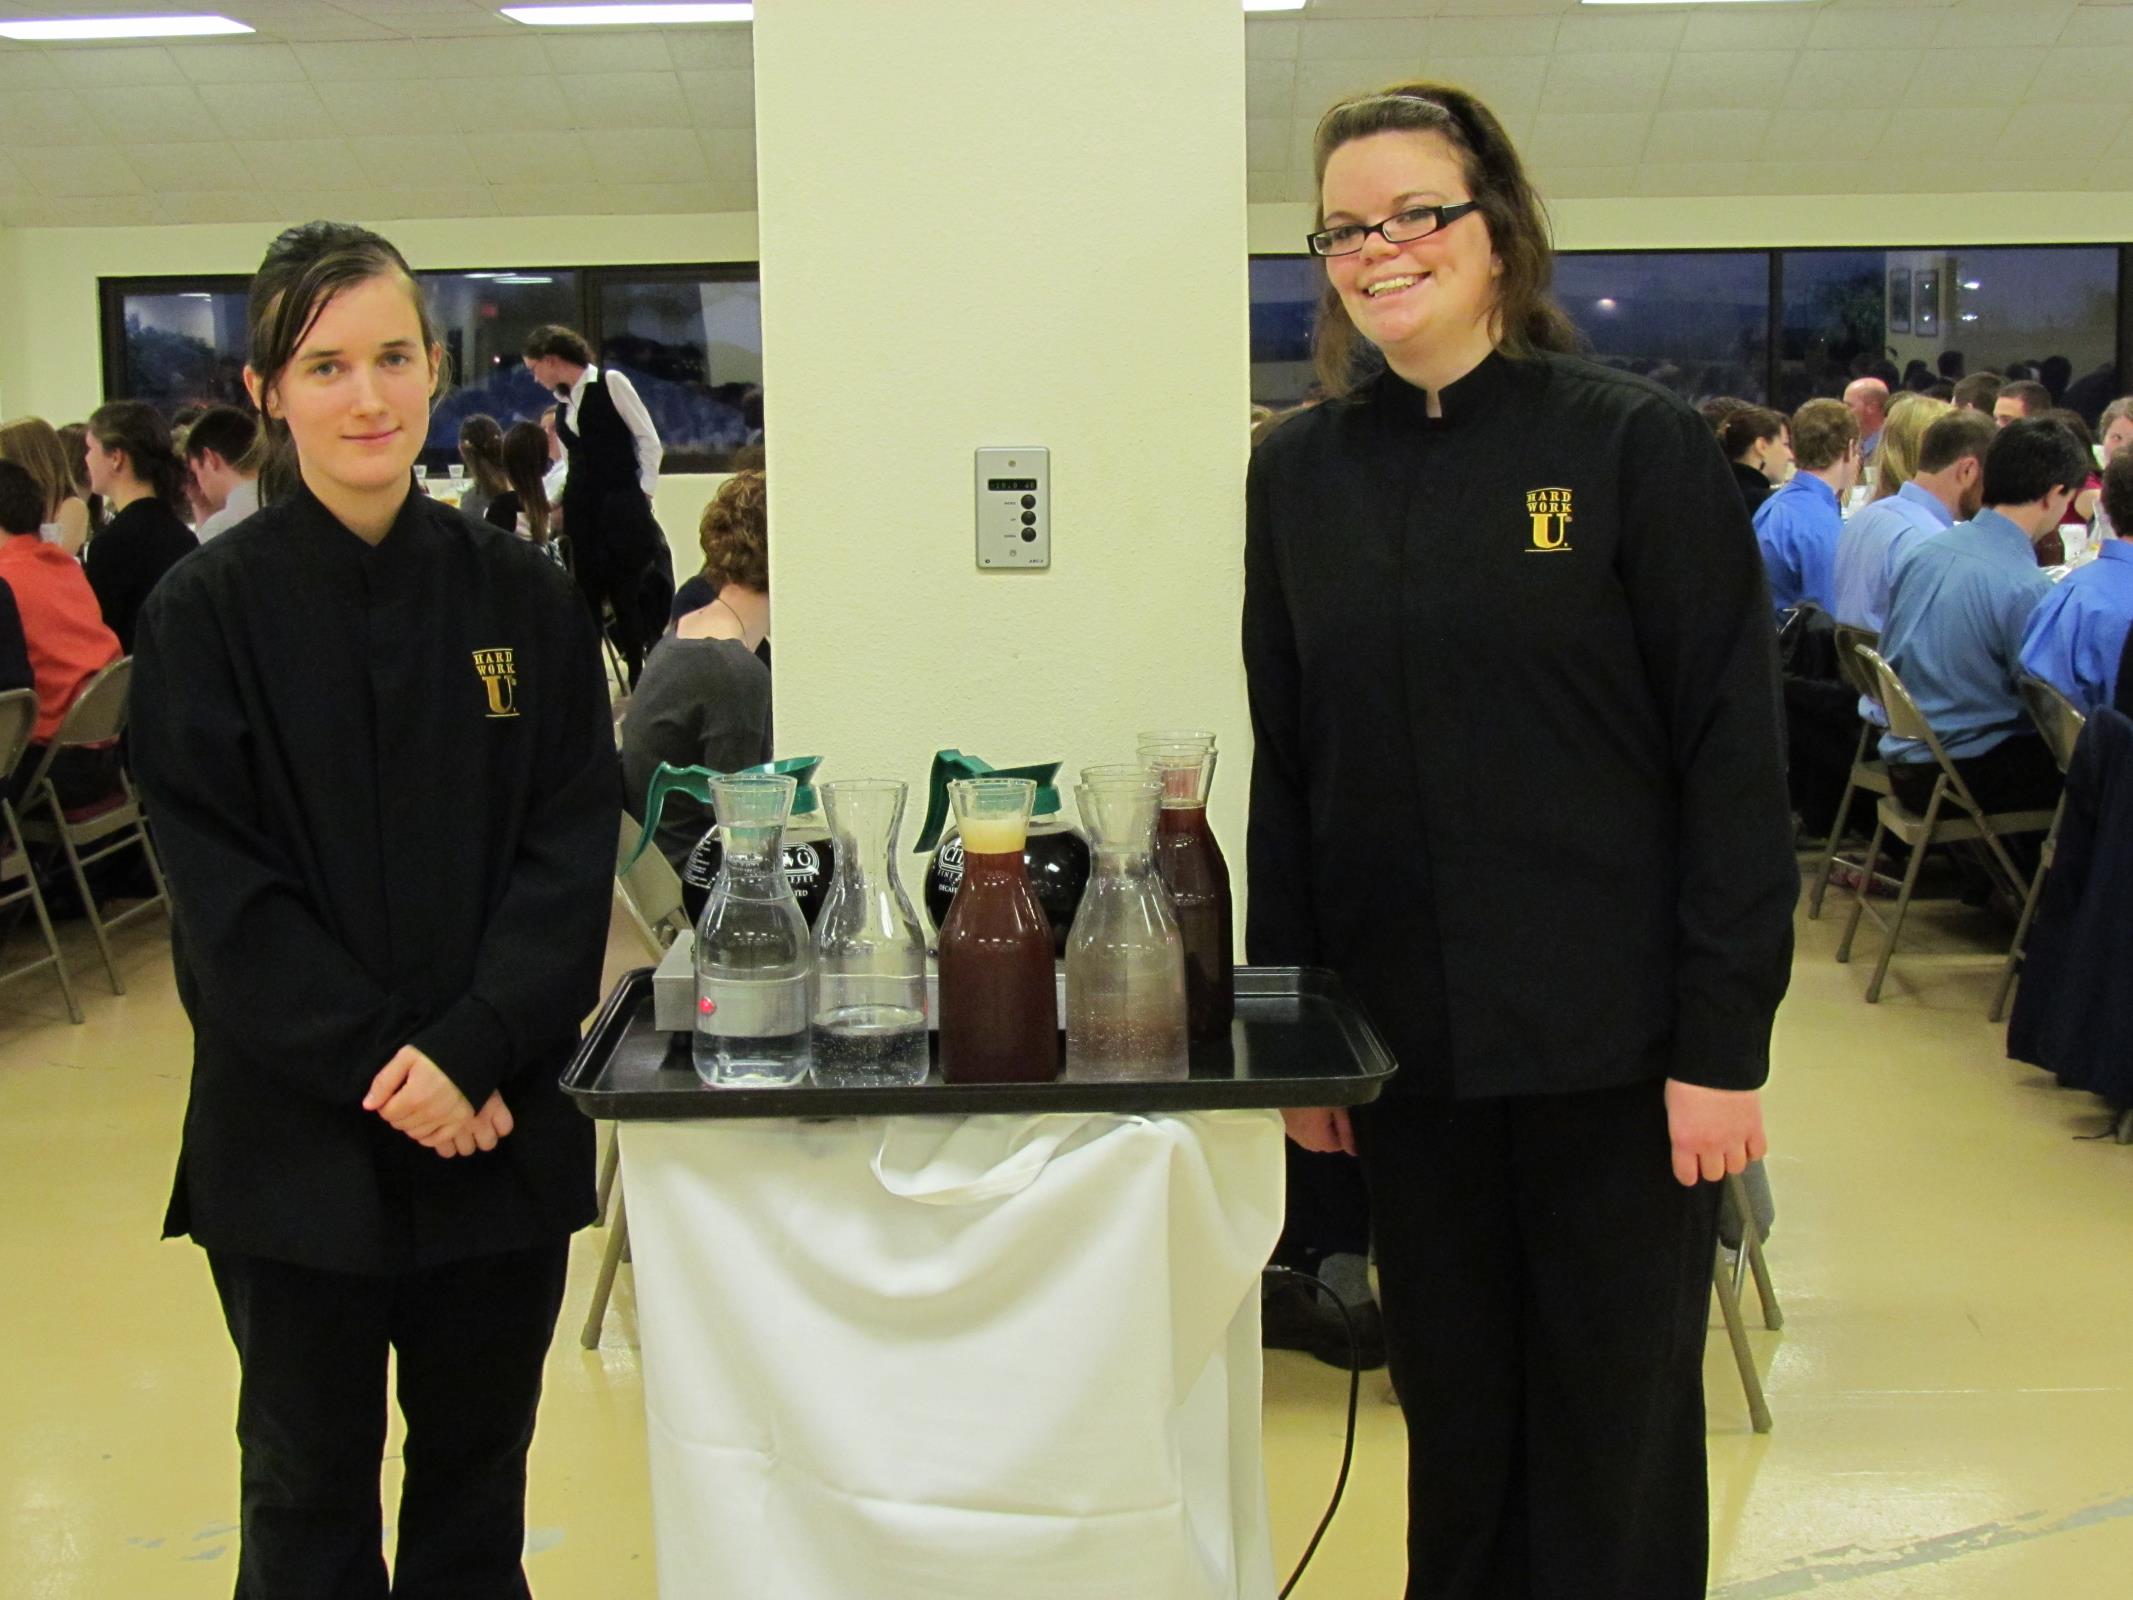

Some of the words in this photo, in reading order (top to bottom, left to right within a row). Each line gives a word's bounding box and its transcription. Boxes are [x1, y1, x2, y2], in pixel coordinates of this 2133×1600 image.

[1527, 491, 1571, 502] HARD
[1527, 502, 1572, 513] WORK
[474, 652, 512, 665] HARD
[476, 664, 516, 676] WORK
